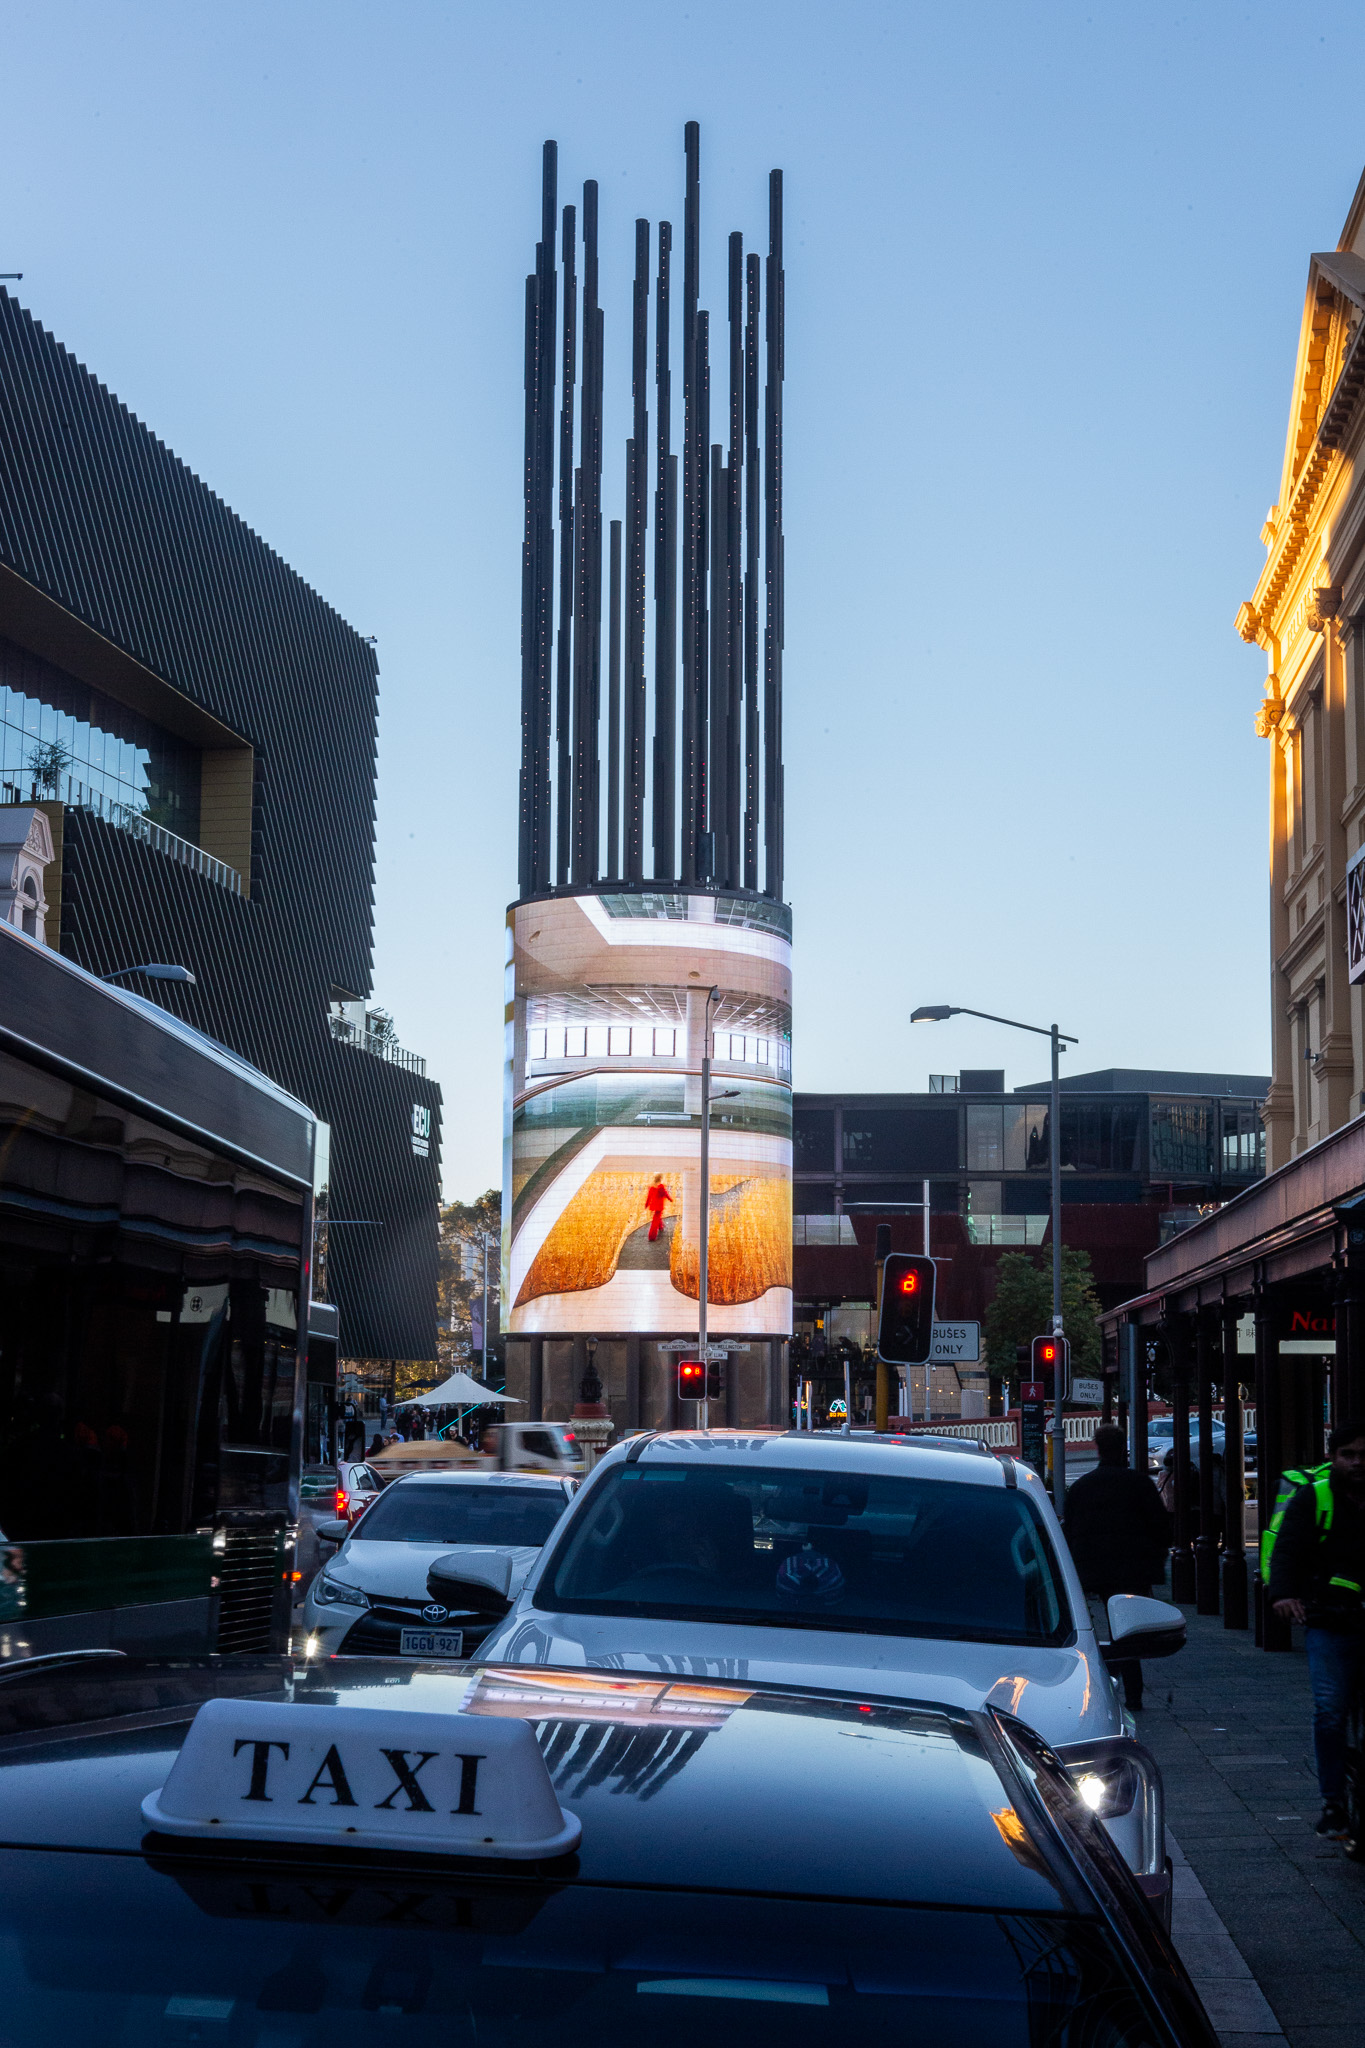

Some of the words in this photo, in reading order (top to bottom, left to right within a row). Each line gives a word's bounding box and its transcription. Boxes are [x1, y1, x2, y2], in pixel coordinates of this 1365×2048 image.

[412, 1104, 431, 1138] ECU
[933, 1328, 966, 1339] BUSES
[935, 1345, 963, 1354] ONLY
[1079, 1382, 1098, 1390] BUSES
[233, 1739, 487, 1816] TAXI
